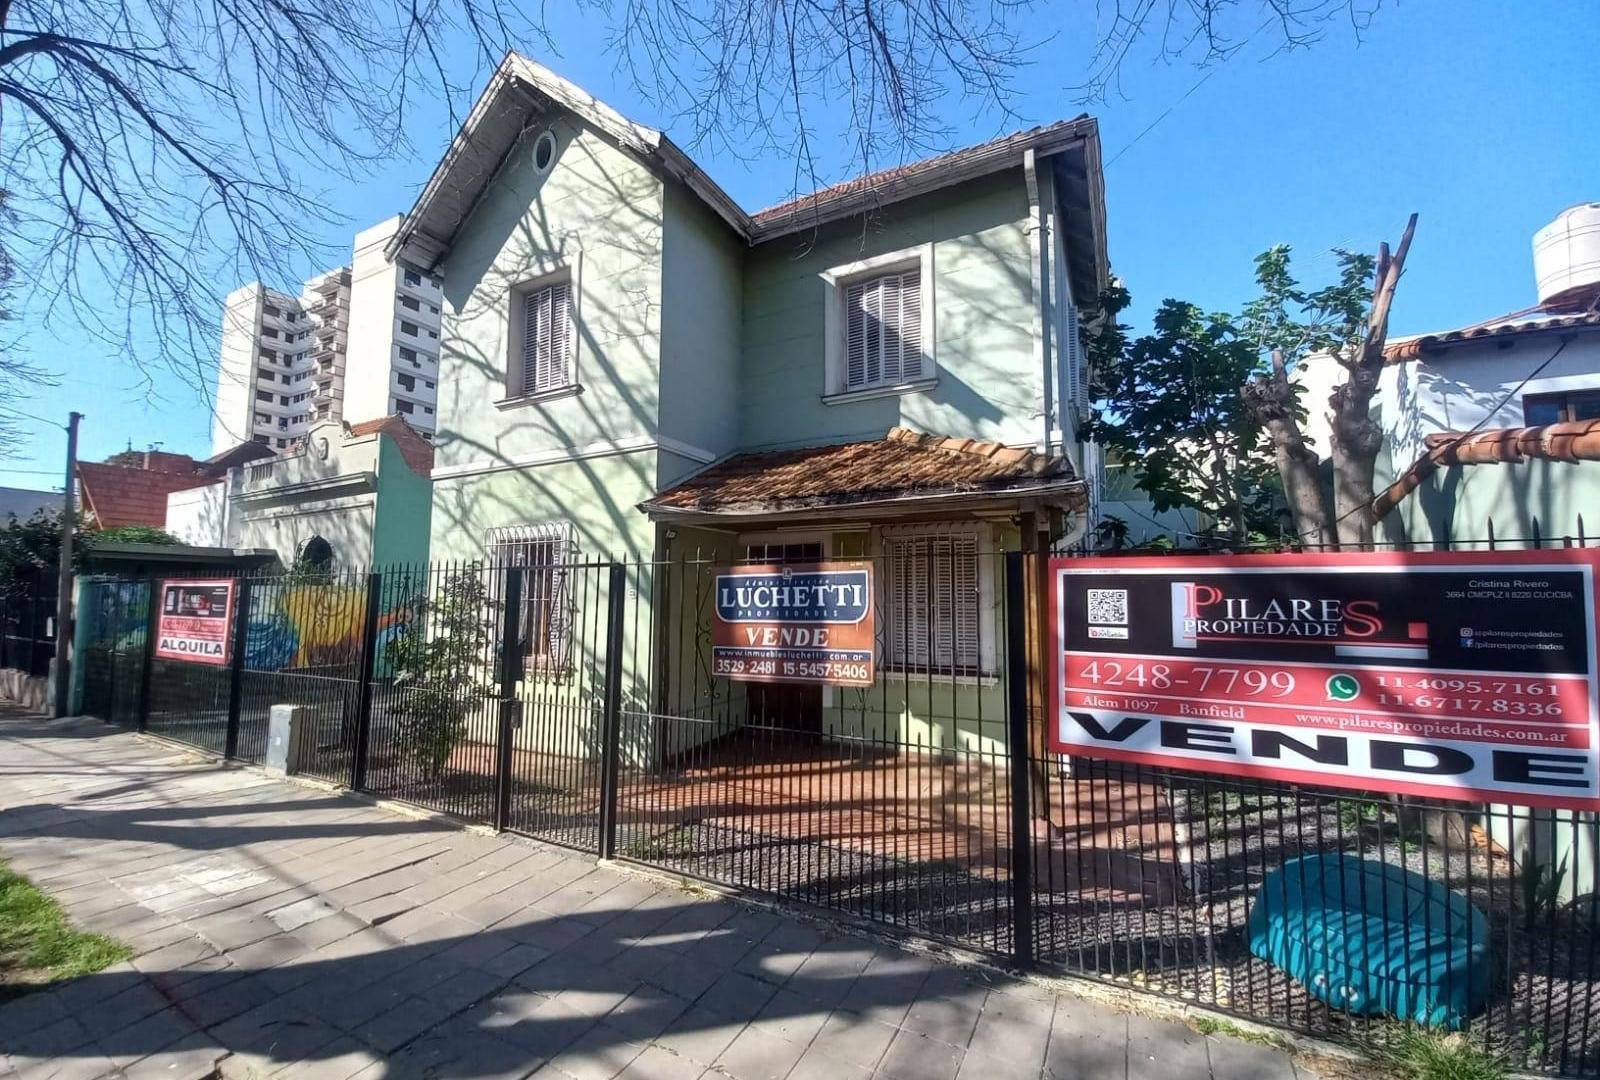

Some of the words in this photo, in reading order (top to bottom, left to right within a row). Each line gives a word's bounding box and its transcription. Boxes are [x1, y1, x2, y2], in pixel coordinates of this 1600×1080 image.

[1468, 580, 1510, 588] Cristina
[1513, 580, 1549, 588] Rivero
[721, 584, 862, 608] LUCHETTI
[738, 610, 838, 618] PROPIEDADES
[1183, 583, 1383, 637] PILARES
[160, 639, 223, 655] ALQUILA
[745, 627, 830, 648] VENDE
[1080, 660, 1296, 698] 4248-7799
[1376, 675, 1560, 697] 11.4095.7161
[1379, 693, 1563, 716] 11.6717.8336
[1082, 694, 1119, 708] Alem
[1123, 699, 1159, 712] 1097
[1179, 703, 1245, 720] Banfield
[1295, 713, 1568, 743] www.pilarespropiedades.com.ar
[1066, 711, 1590, 788] VENDE
